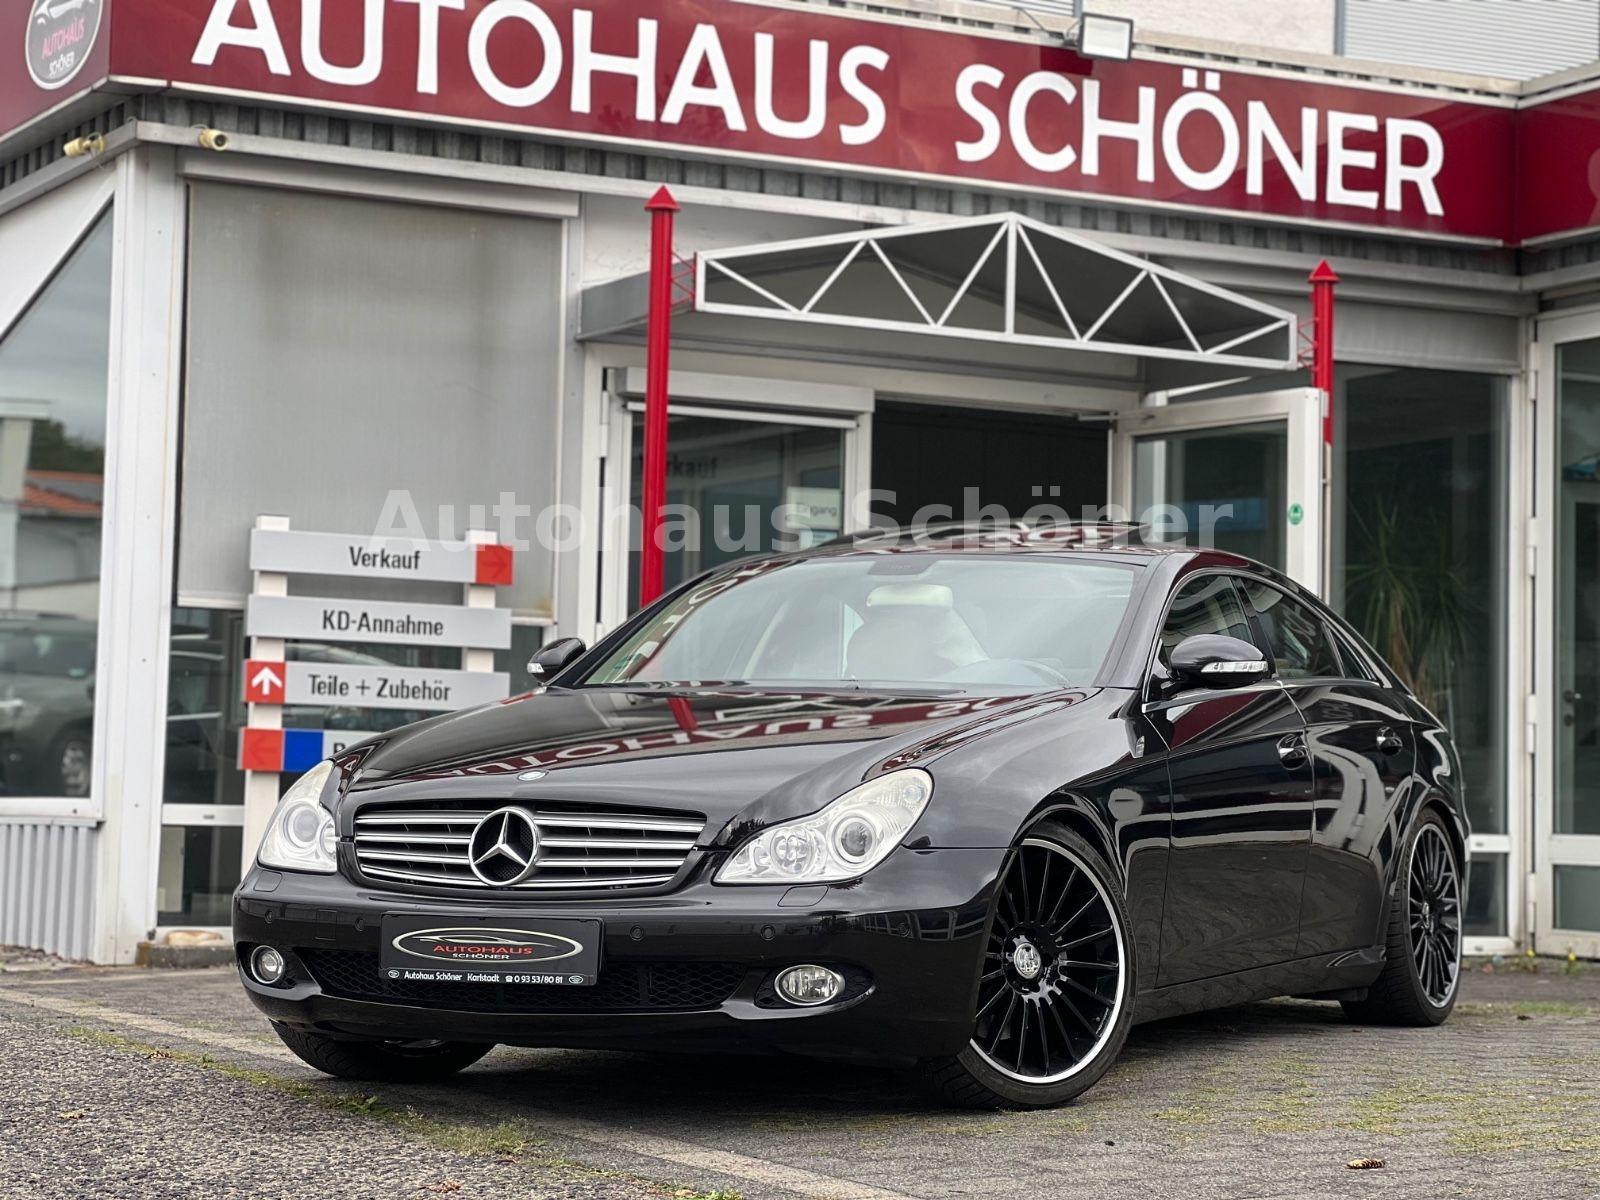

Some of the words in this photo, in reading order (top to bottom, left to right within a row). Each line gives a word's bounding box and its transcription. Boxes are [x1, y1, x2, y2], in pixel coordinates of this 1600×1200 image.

[41, 17, 85, 59] AUTOHAUS
[191, 0, 890, 145] AUTOHAUS
[955, 63, 1444, 216] SCHÖNER
[349, 545, 421, 571] Verkauf
[322, 609, 444, 636] KD-Annahme
[308, 674, 350, 697] Teile
[376, 678, 452, 702] Zubehör
[433, 944, 533, 956] AUTOHAUS
[452, 952, 511, 960] SCHÖNER
[404, 970, 434, 981] Autohaus
[436, 971, 462, 982] Schöner
[467, 973, 500, 983] Karlstadt
[521, 976, 530, 984] 93
[531, 975, 554, 985] 53/80
[555, 976, 564, 985] 81
